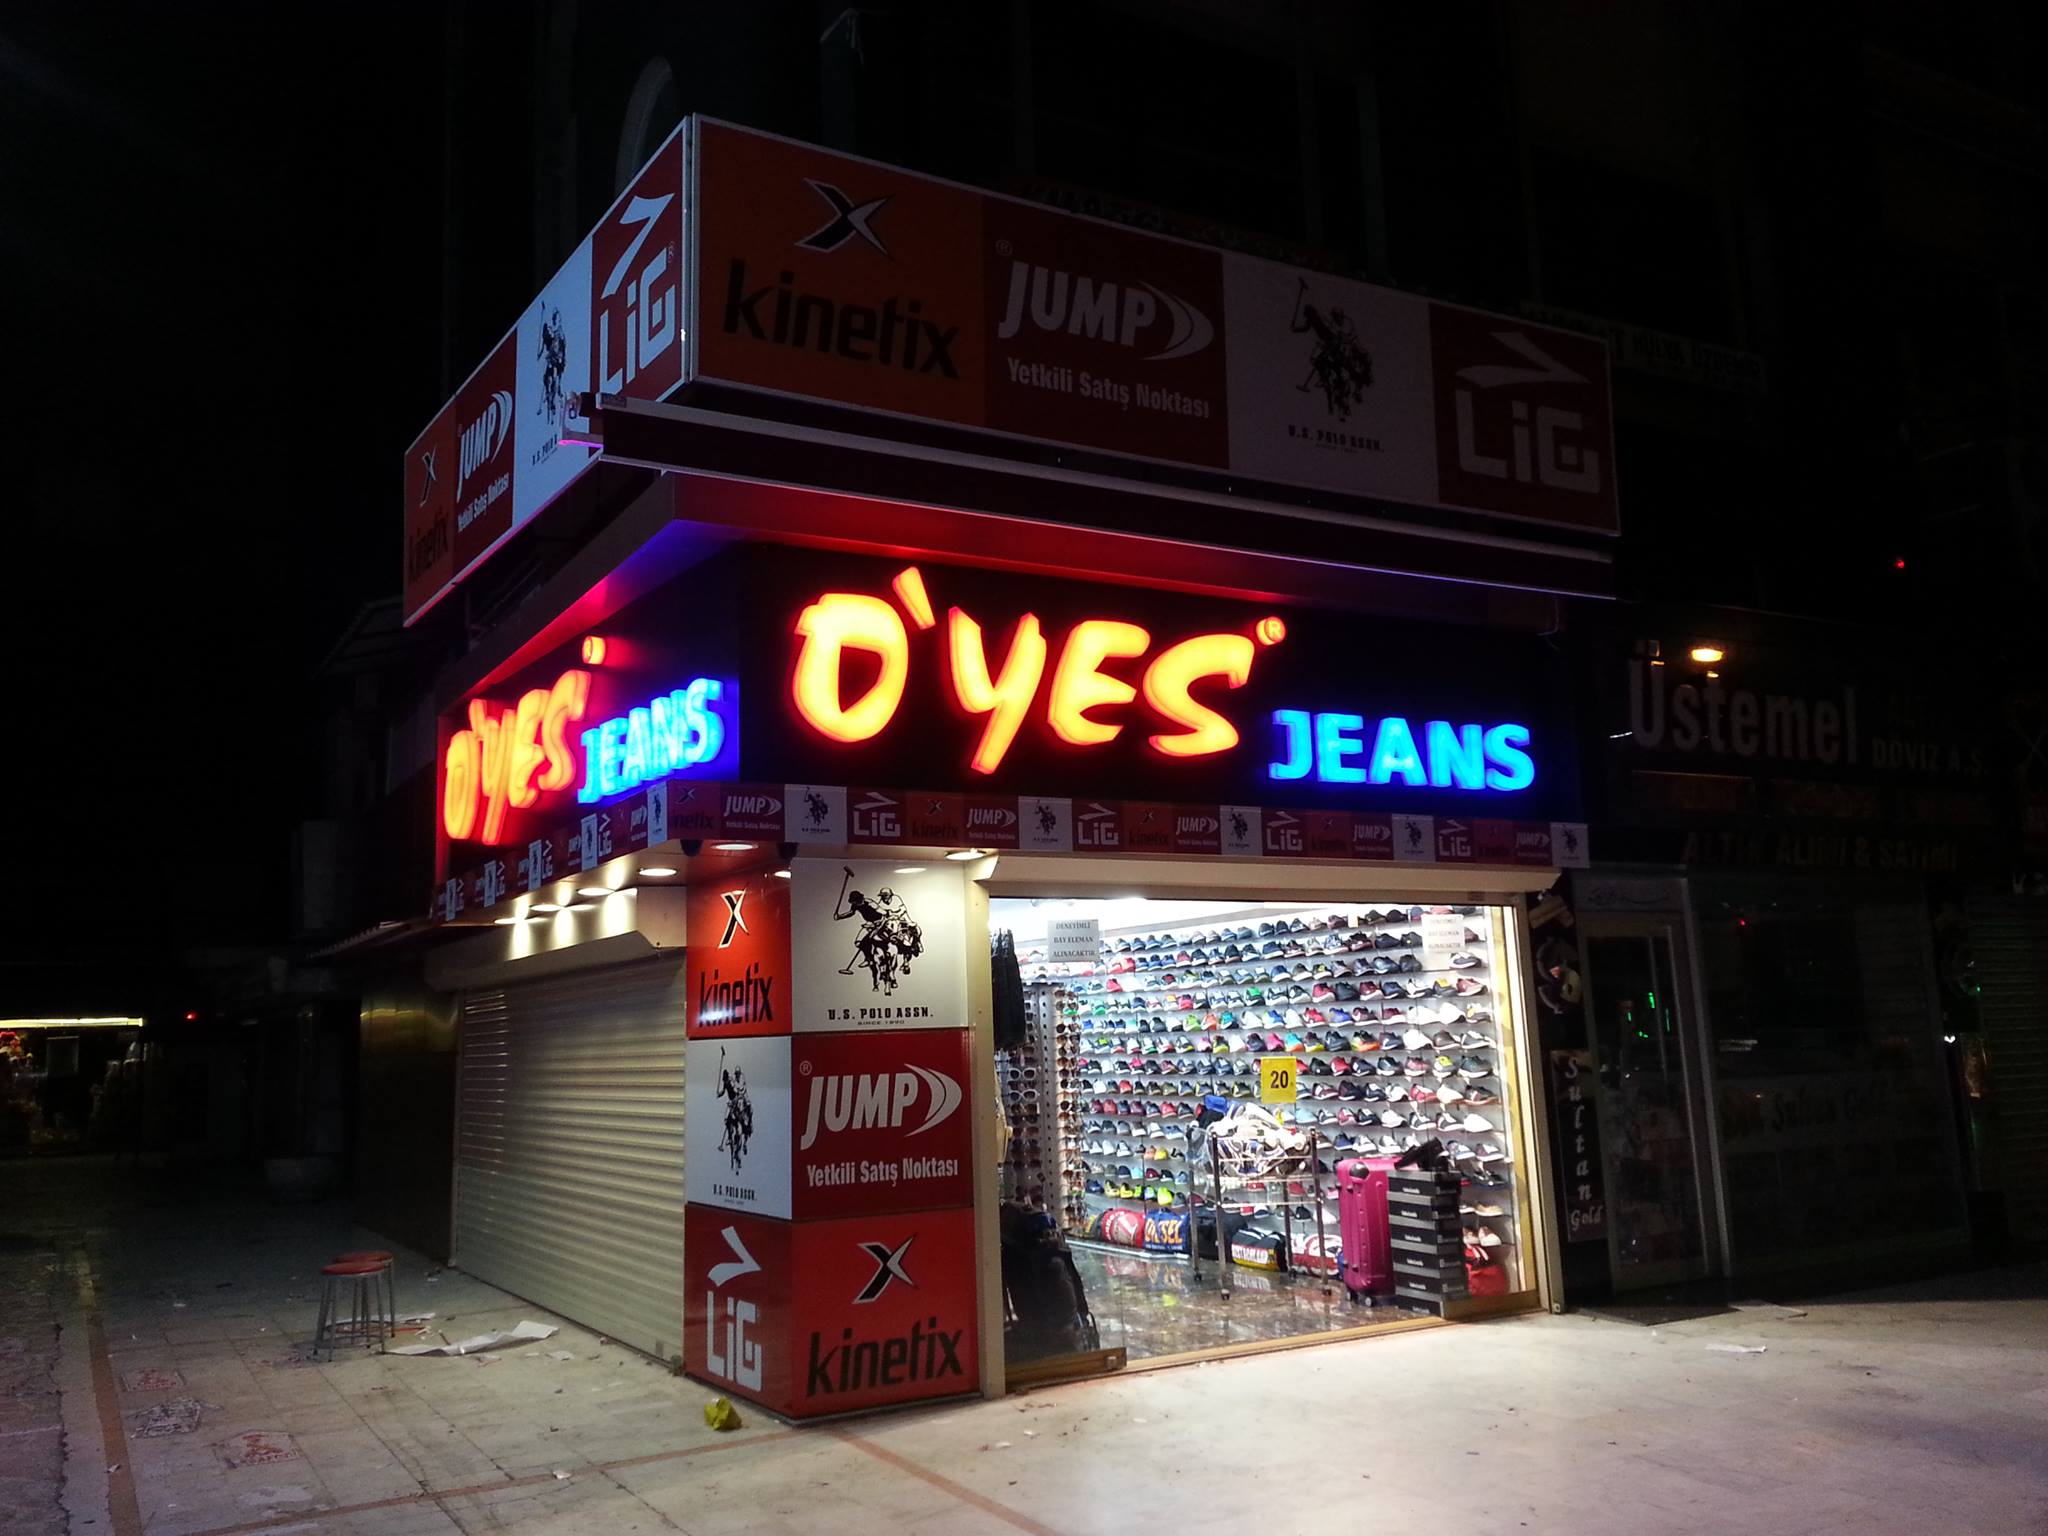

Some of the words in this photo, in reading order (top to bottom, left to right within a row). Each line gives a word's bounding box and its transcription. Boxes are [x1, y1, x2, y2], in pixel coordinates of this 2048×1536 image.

[722, 258, 961, 379] kinetix
[997, 261, 1159, 348] JUMP
[1006, 356, 1074, 395] Yetkili
[1079, 371, 1132, 413] Satış
[1136, 386, 1210, 419] Noktası
[456, 400, 499, 504] JUMP
[791, 565, 1257, 776] O'YES
[1269, 709, 1536, 792] JEANS
[577, 677, 725, 804] JEANS
[723, 794, 768, 818] JUMP
[966, 808, 1002, 831] JUMP
[1175, 815, 1207, 835] JUMP
[697, 962, 774, 1028] kinetix
[827, 1008, 856, 1020] U.S.
[860, 1007, 892, 1019] POLO
[896, 1006, 935, 1018] ASSN.
[800, 1072, 920, 1151] JUMP
[1270, 1070, 1289, 1089] 20
[806, 1161, 856, 1188] Yetkili
[859, 1159, 899, 1188] Satış
[902, 1156, 960, 1180] Noktası
[806, 1316, 964, 1398] kinetix
